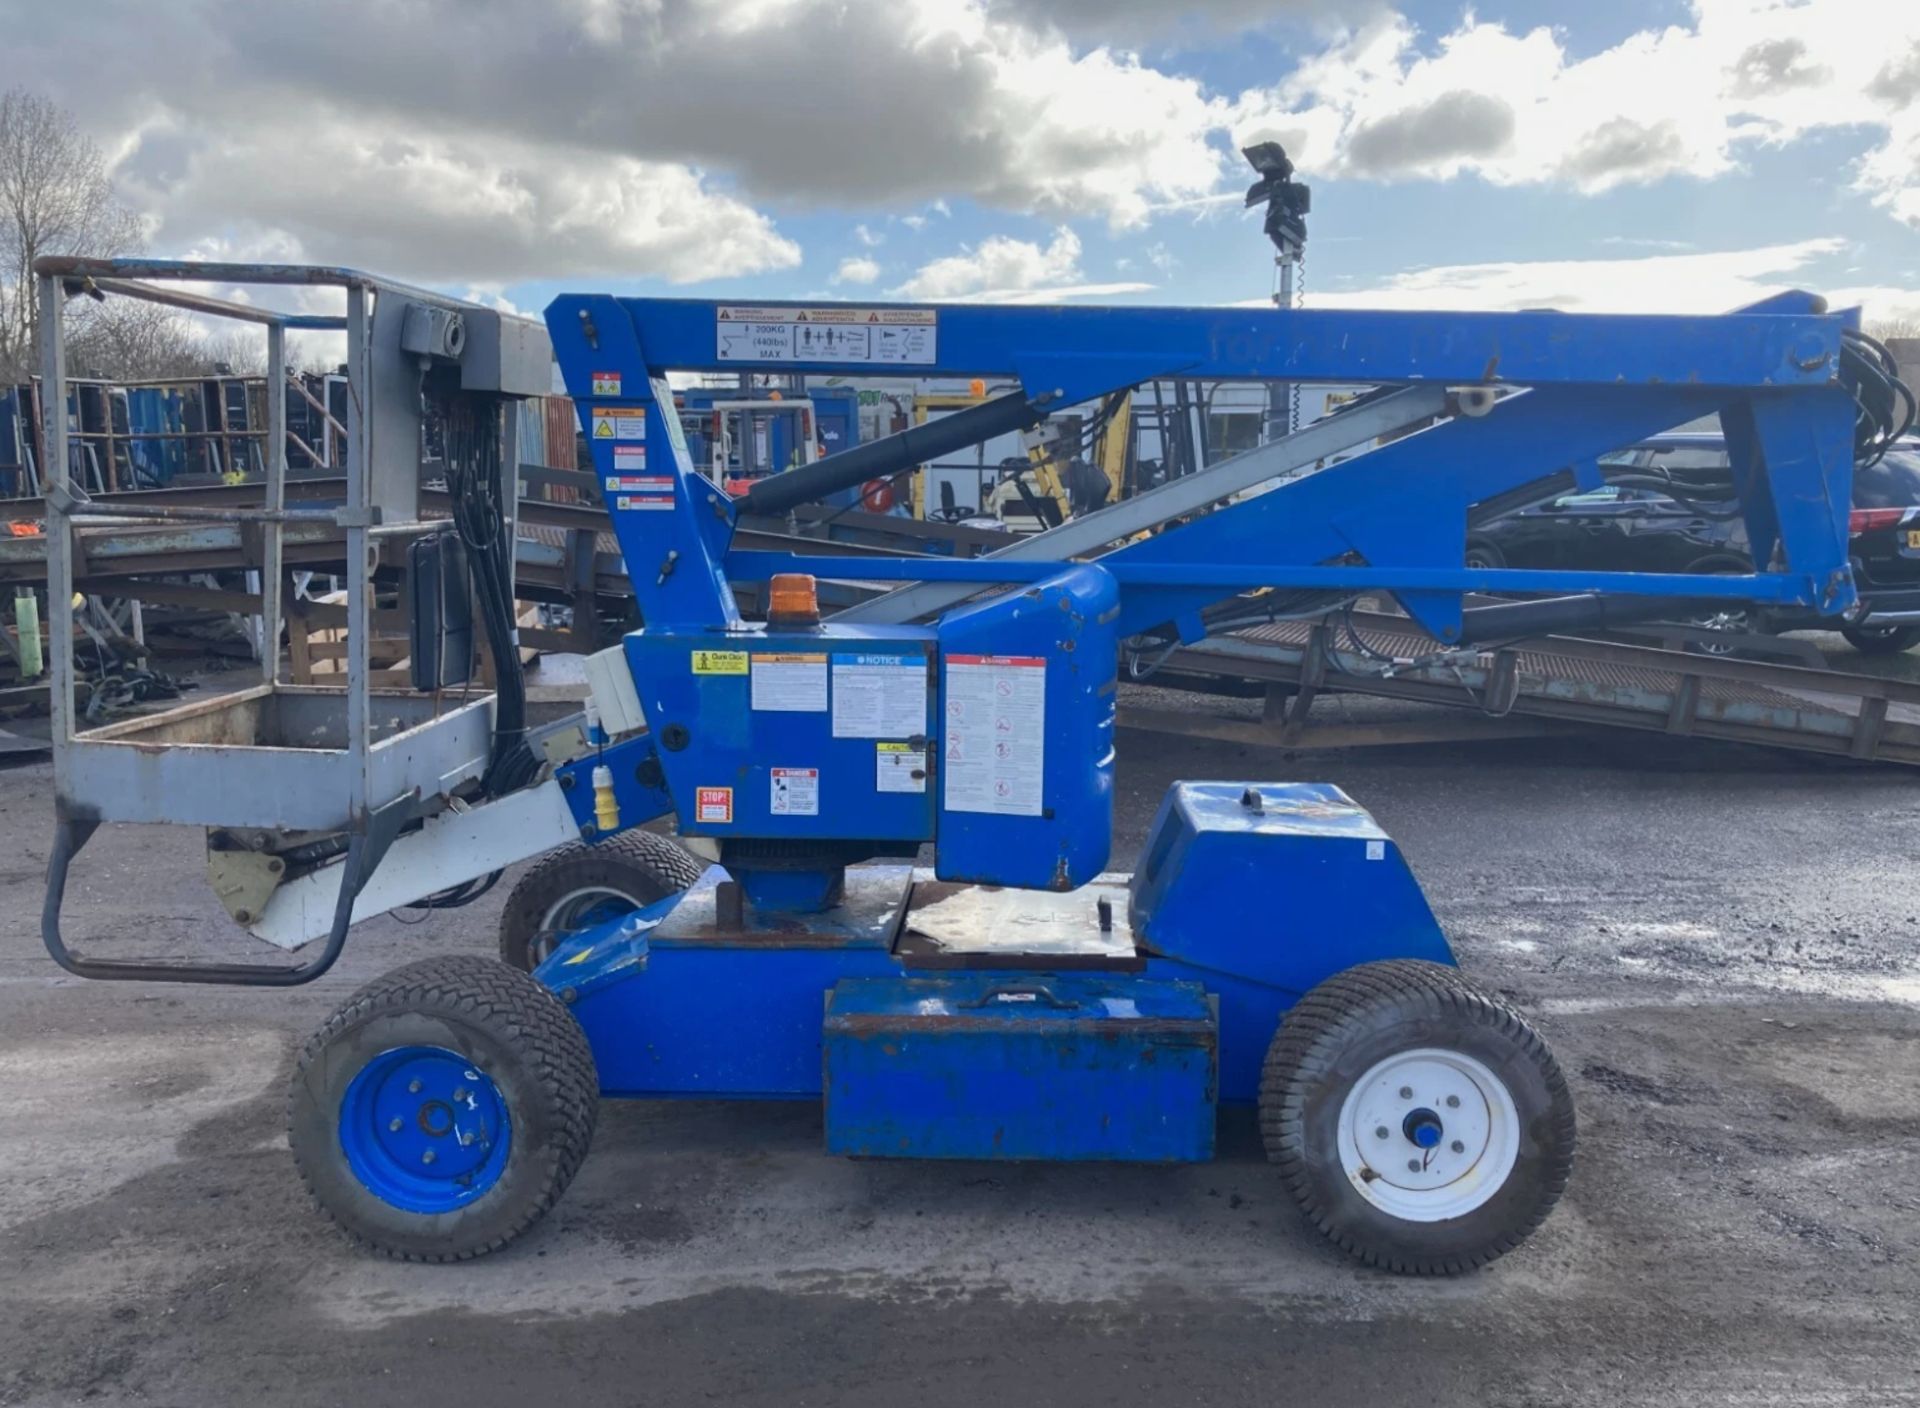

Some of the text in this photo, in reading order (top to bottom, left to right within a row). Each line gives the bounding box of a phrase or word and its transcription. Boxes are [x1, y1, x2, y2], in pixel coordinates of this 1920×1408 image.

[755, 325, 785, 333] 200KG
[752, 337, 788, 348] (440lbs)
[760, 350, 781, 358] MAX
[866, 655, 902, 665] NOTICE
[702, 791, 728, 802] STOP!
